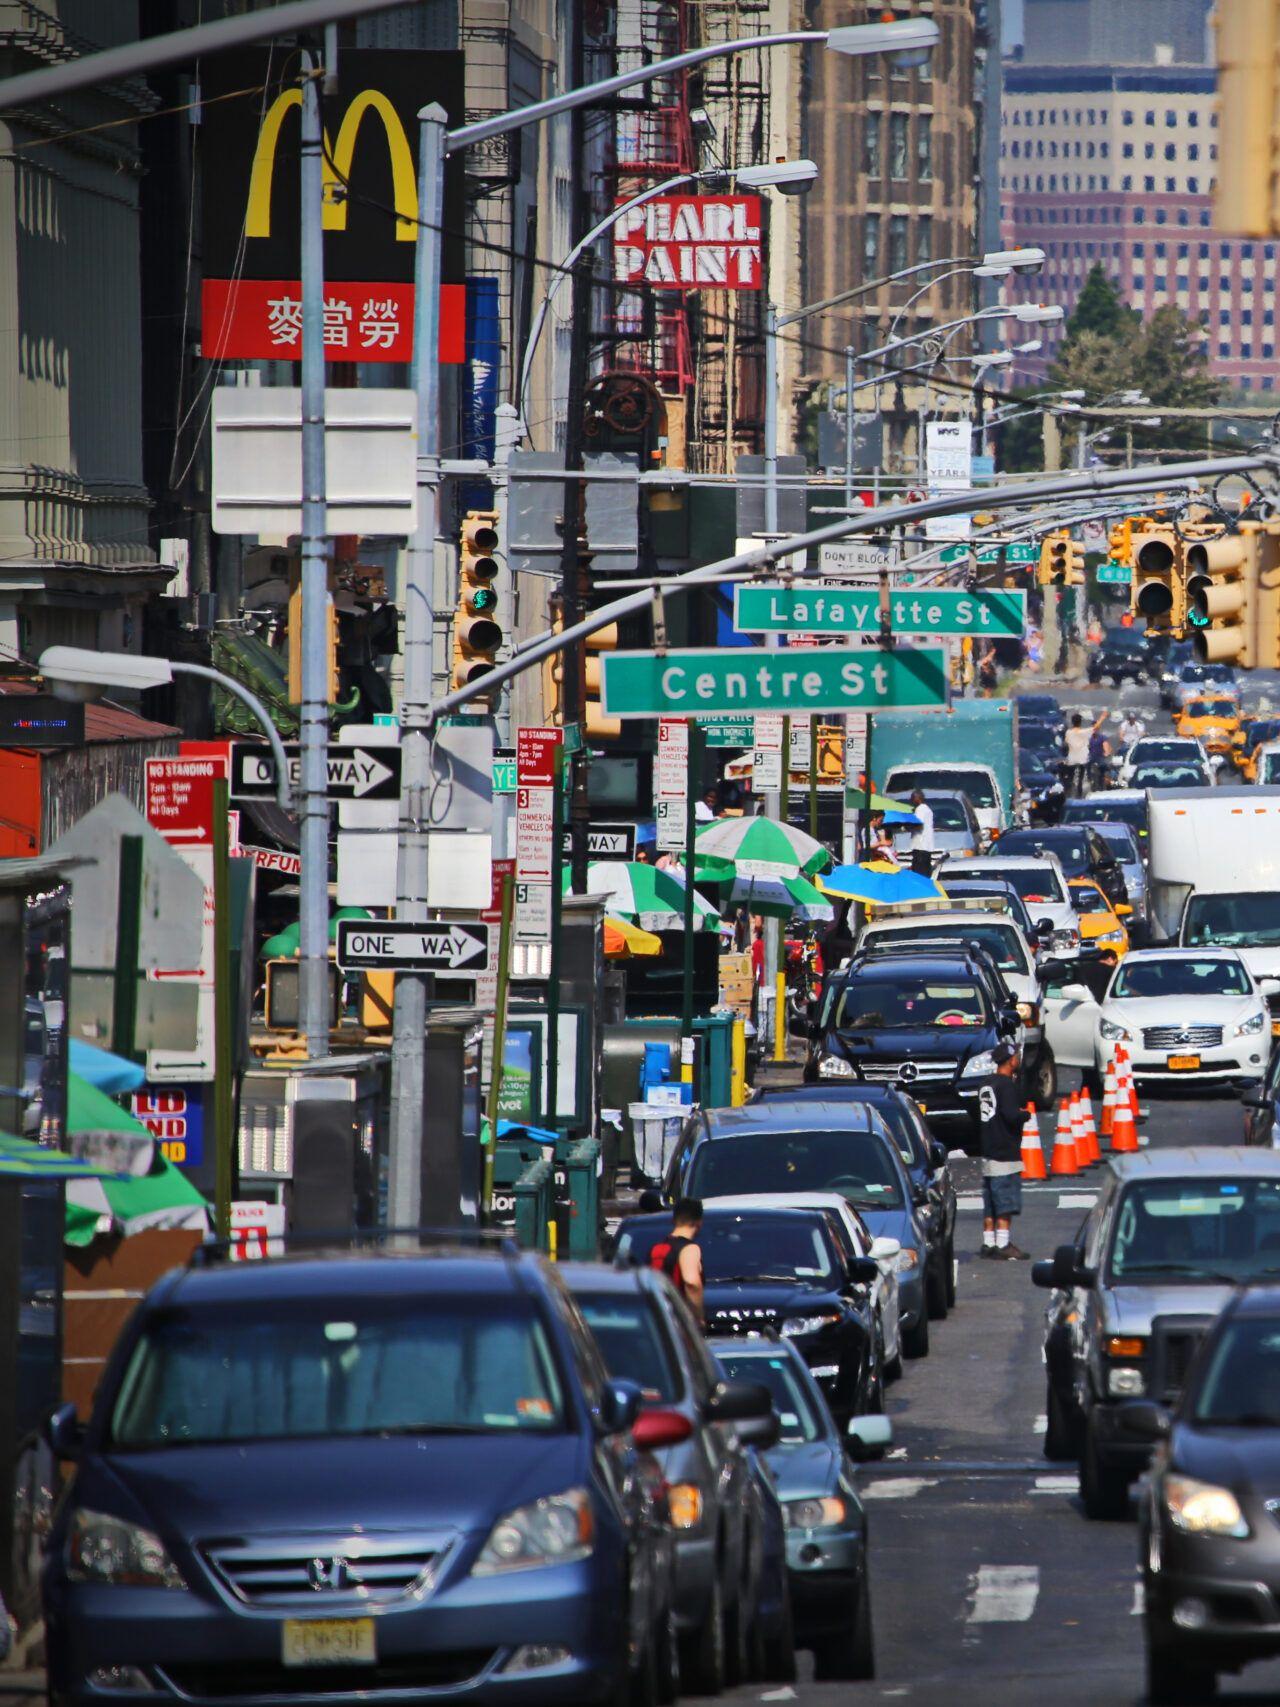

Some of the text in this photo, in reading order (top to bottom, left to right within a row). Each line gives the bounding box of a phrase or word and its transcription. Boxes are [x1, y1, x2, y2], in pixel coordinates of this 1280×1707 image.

[614, 203, 760, 241] PEARL
[614, 245, 761, 283] PAINT
[267, 296, 400, 348] 麥當勞
[857, 552, 890, 564] BLOCK
[955, 601, 990, 624] St
[661, 663, 888, 700] Centre St
[529, 731, 557, 740] STANDING
[662, 728, 669, 740] 3
[755, 753, 762, 765] 5
[165, 762, 213, 777] STANDING
[256, 761, 375, 782] OE WAY
[519, 791, 527, 807] 3
[659, 803, 667, 817] 5
[518, 885, 527, 903] 5
[352, 936, 468, 956] ONE WAY
